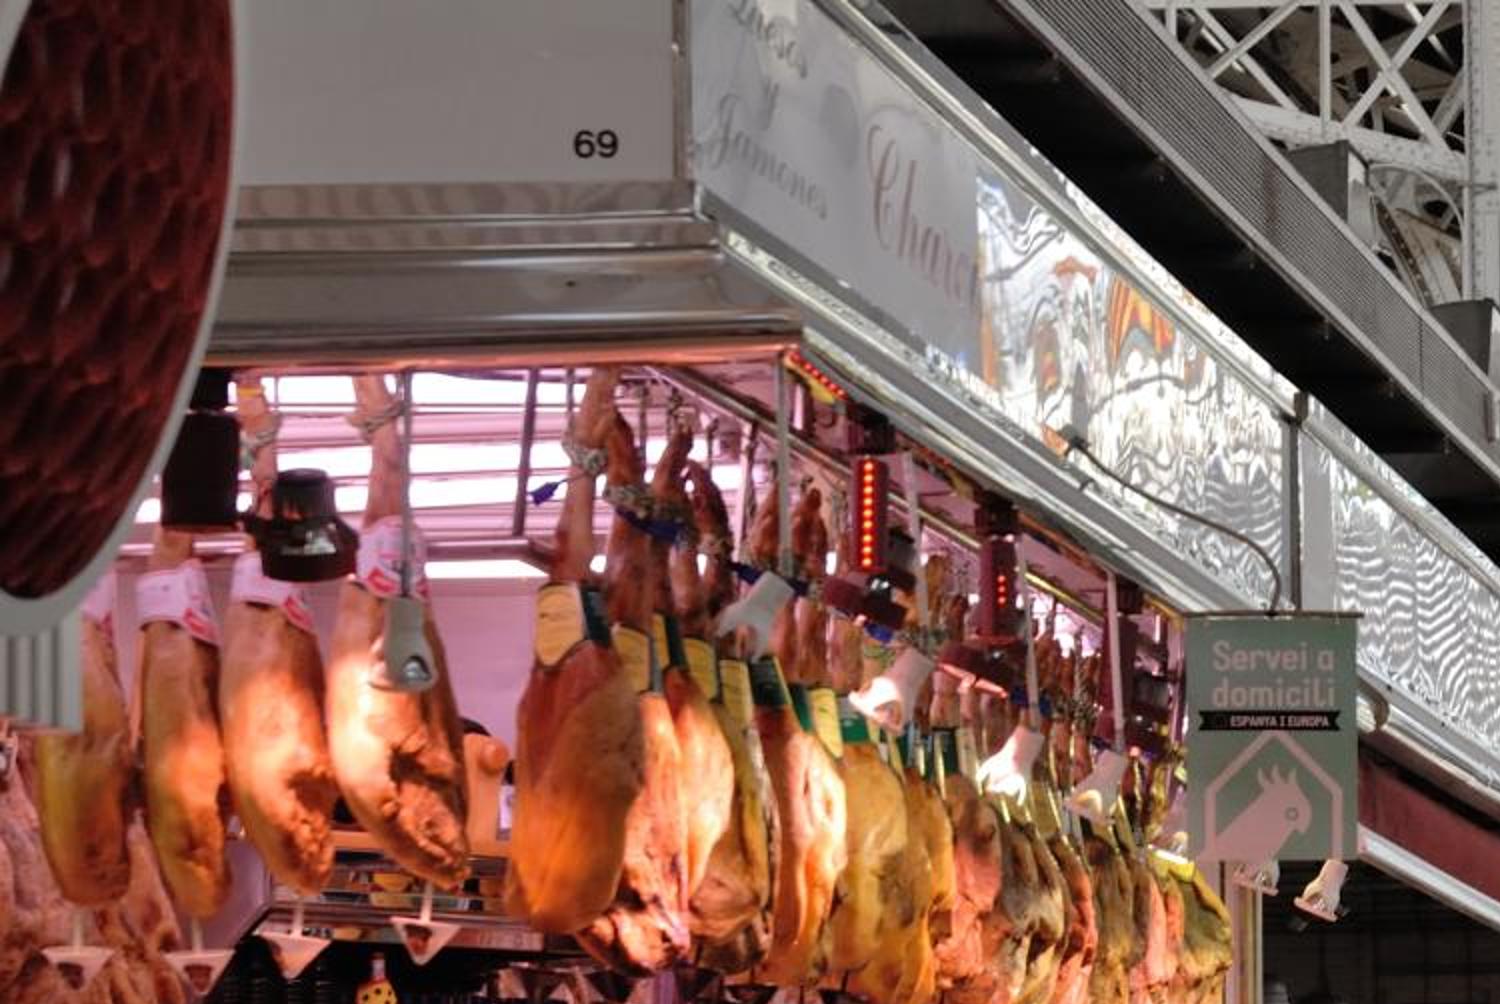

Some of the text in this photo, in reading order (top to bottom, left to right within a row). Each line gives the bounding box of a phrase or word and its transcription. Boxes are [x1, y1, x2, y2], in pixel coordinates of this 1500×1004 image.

[574, 130, 618, 159] 69
[696, 93, 828, 221] Jamones
[1212, 639, 1335, 672] Servei a
[1212, 676, 1336, 708] domicili
[1230, 715, 1278, 727] ESPANYA
[1288, 715, 1329, 727] EUROPA
